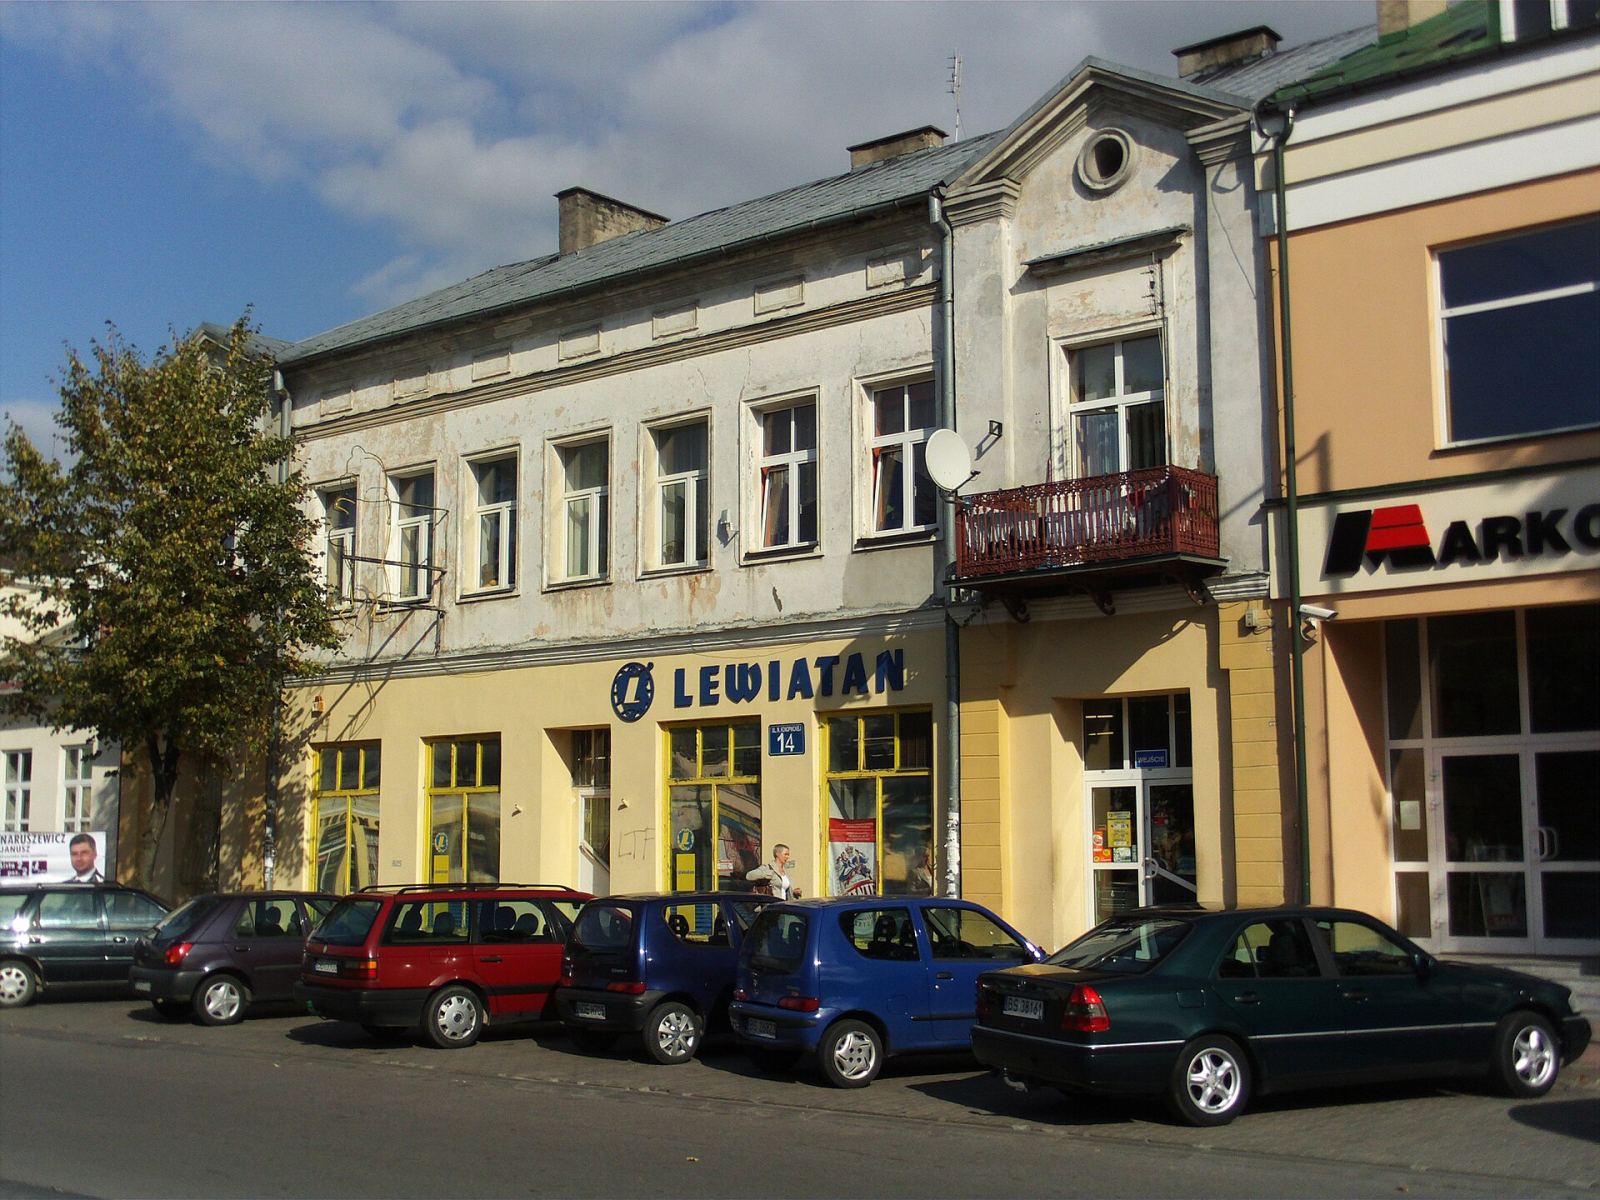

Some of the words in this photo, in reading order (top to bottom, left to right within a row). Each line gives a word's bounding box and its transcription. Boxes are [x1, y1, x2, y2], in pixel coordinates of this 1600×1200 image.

[673, 648, 904, 709] LEWIATAN
[777, 732, 795, 753] 14
[0, 833, 66, 844] NARUSZEWICZ
[0, 845, 30, 853] JANUSZ
